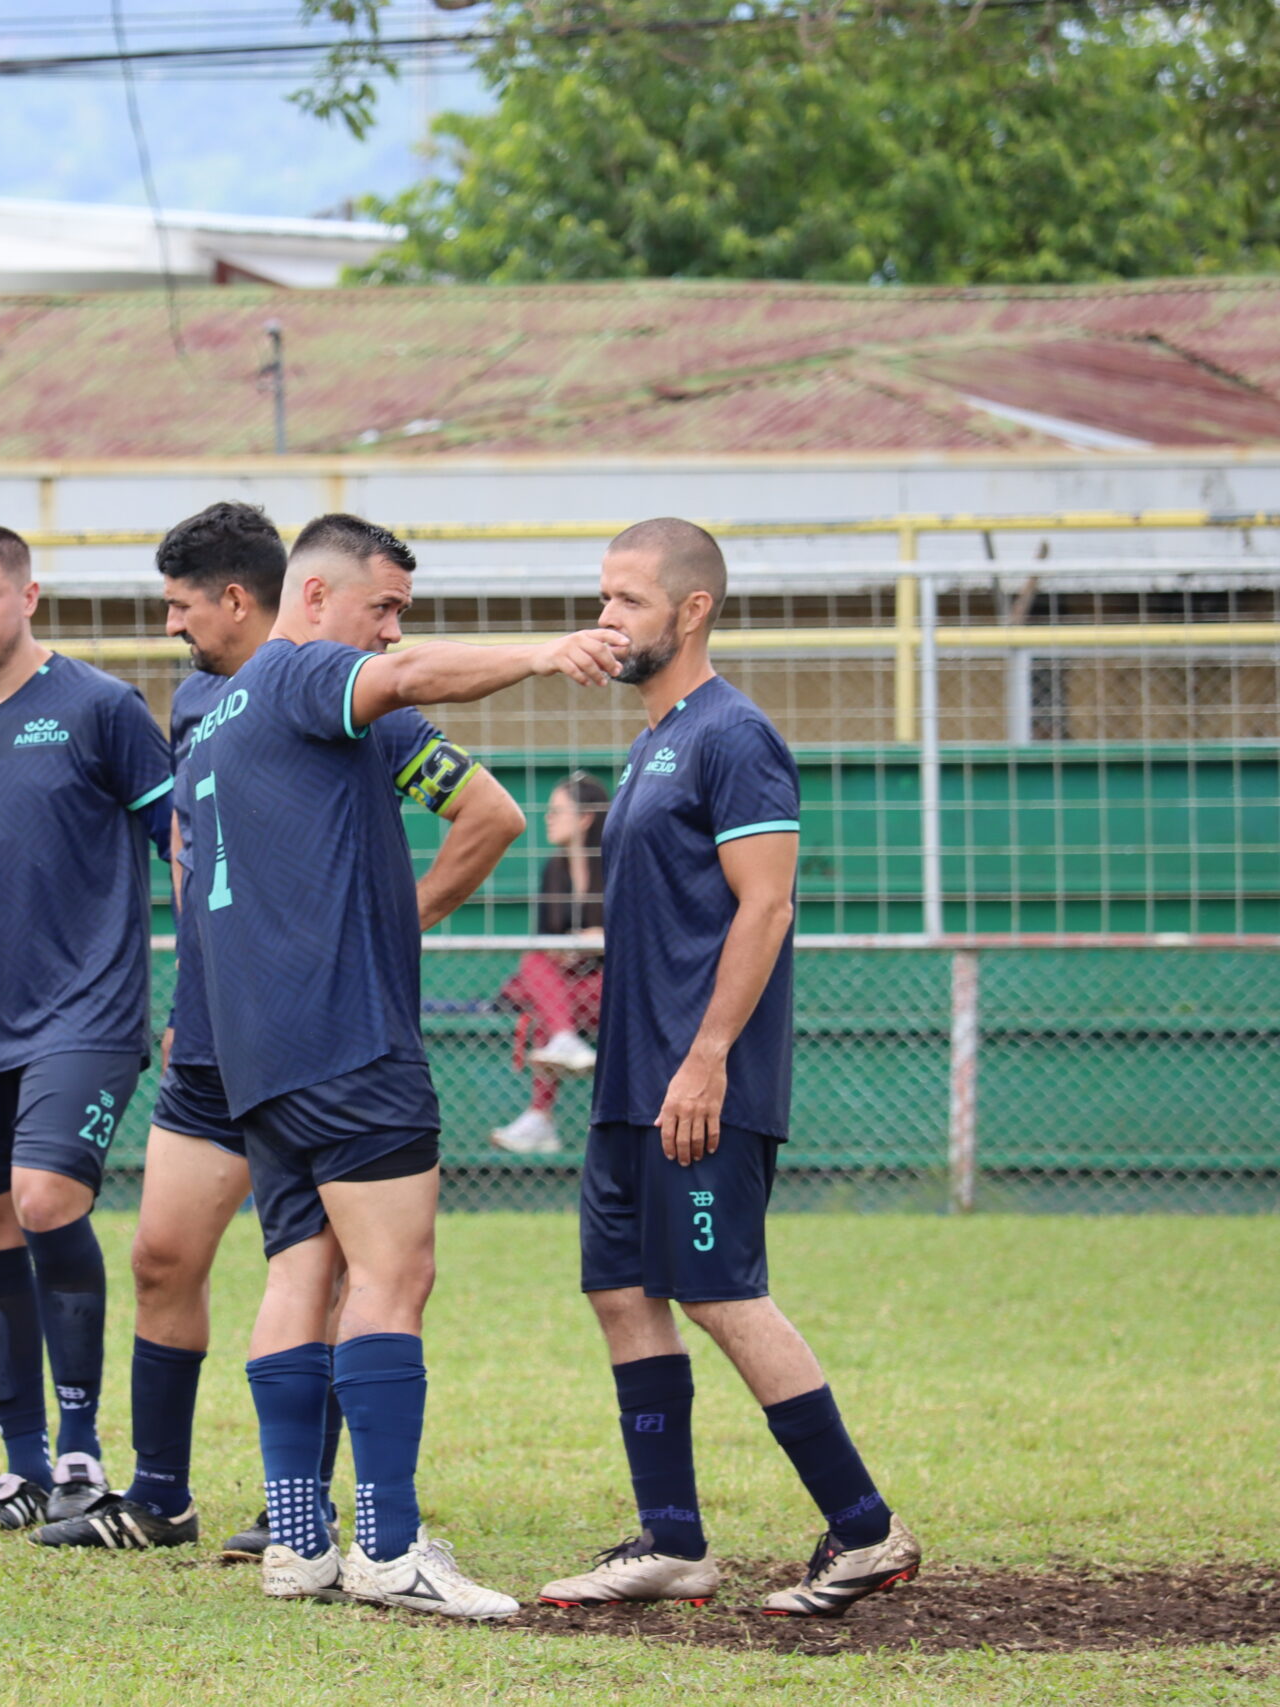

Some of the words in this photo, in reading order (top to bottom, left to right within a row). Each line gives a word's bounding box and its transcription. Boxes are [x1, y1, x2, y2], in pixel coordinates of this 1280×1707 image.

[13, 730, 70, 746] ANEJUD
[78, 1103, 115, 1149] 23
[692, 1211, 715, 1252] 3
